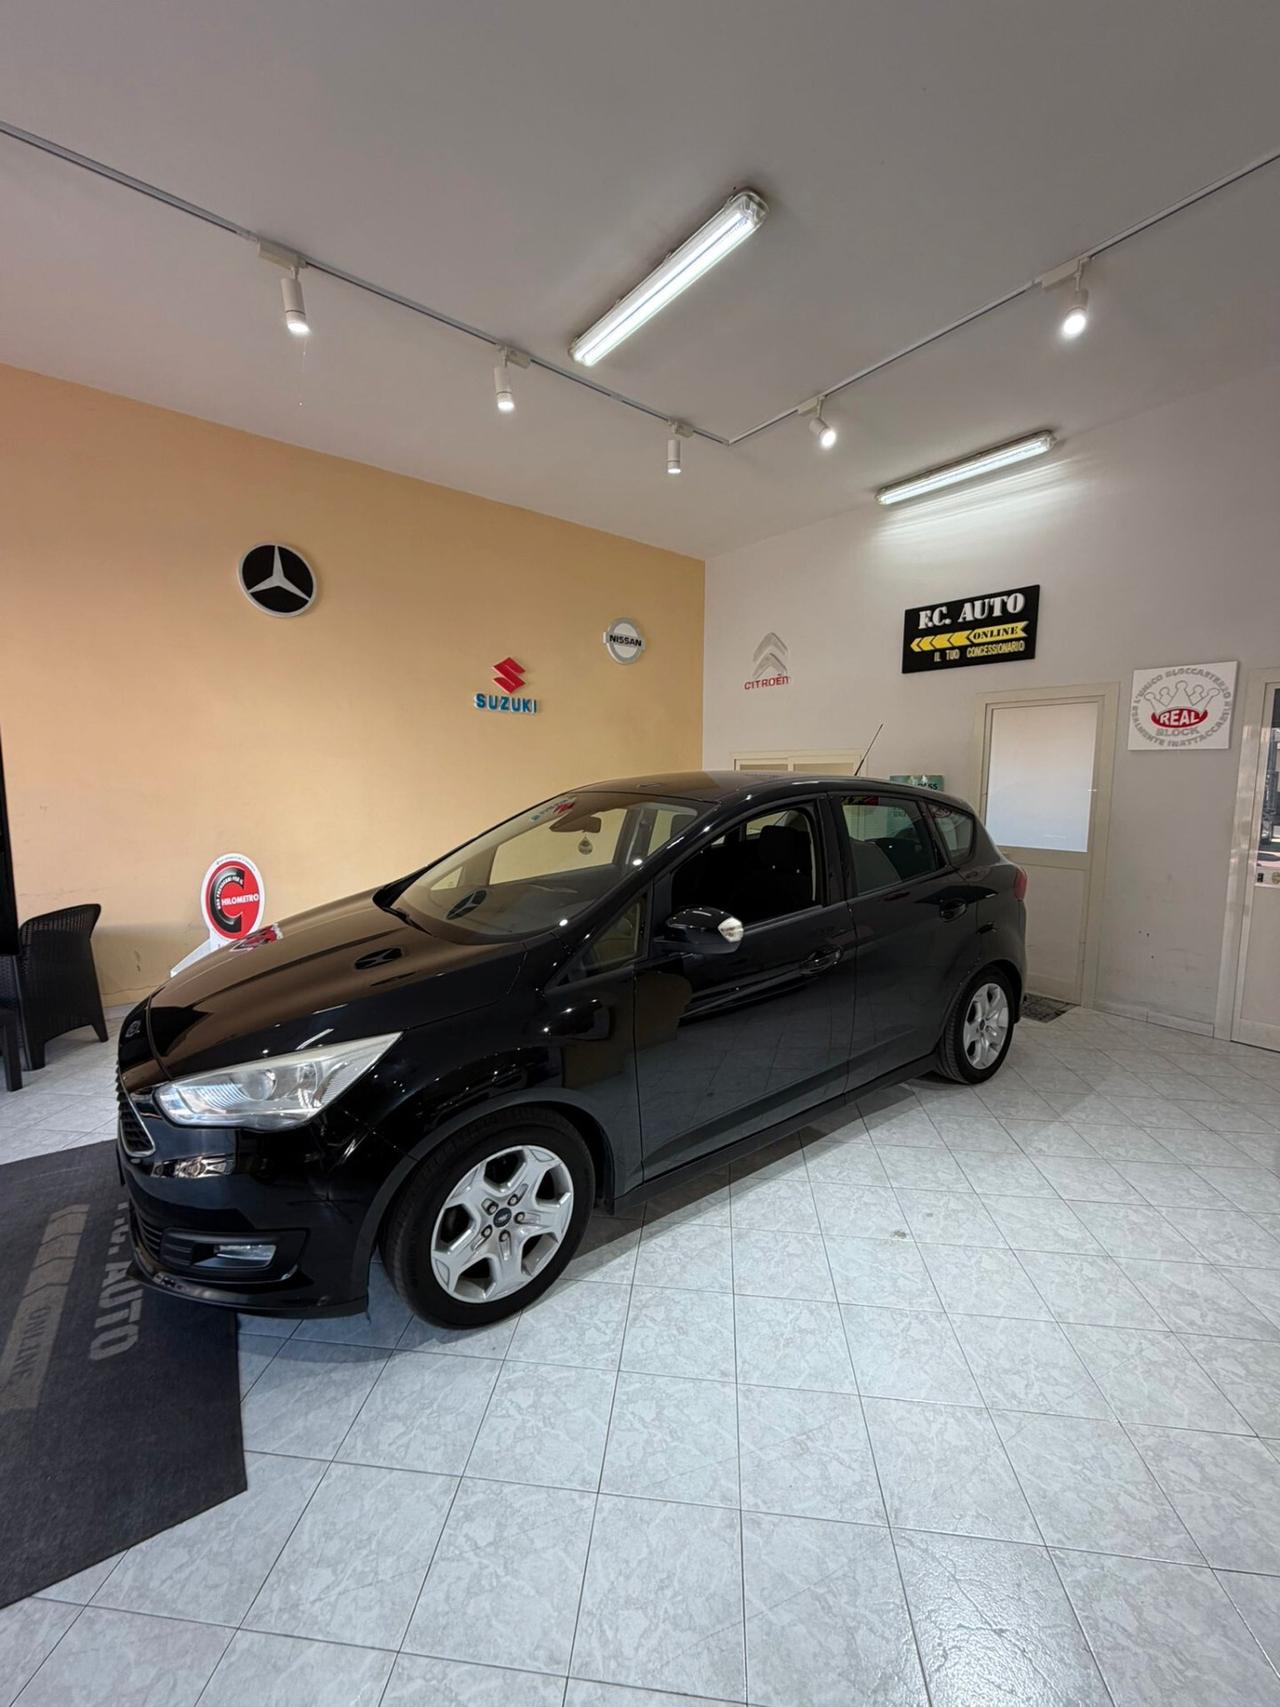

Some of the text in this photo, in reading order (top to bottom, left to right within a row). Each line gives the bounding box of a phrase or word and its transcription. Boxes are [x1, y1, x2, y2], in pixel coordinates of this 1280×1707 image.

[918, 592, 1026, 630] F.C. AUTO
[609, 634, 642, 647] NISSAN
[973, 626, 1019, 640] ONLINE
[934, 640, 1026, 662] IL TUO CONCESSIONARIO
[473, 693, 537, 714] SUZUKI
[1159, 709, 1200, 726] REAL
[89, 1259, 145, 1361] AUTO
